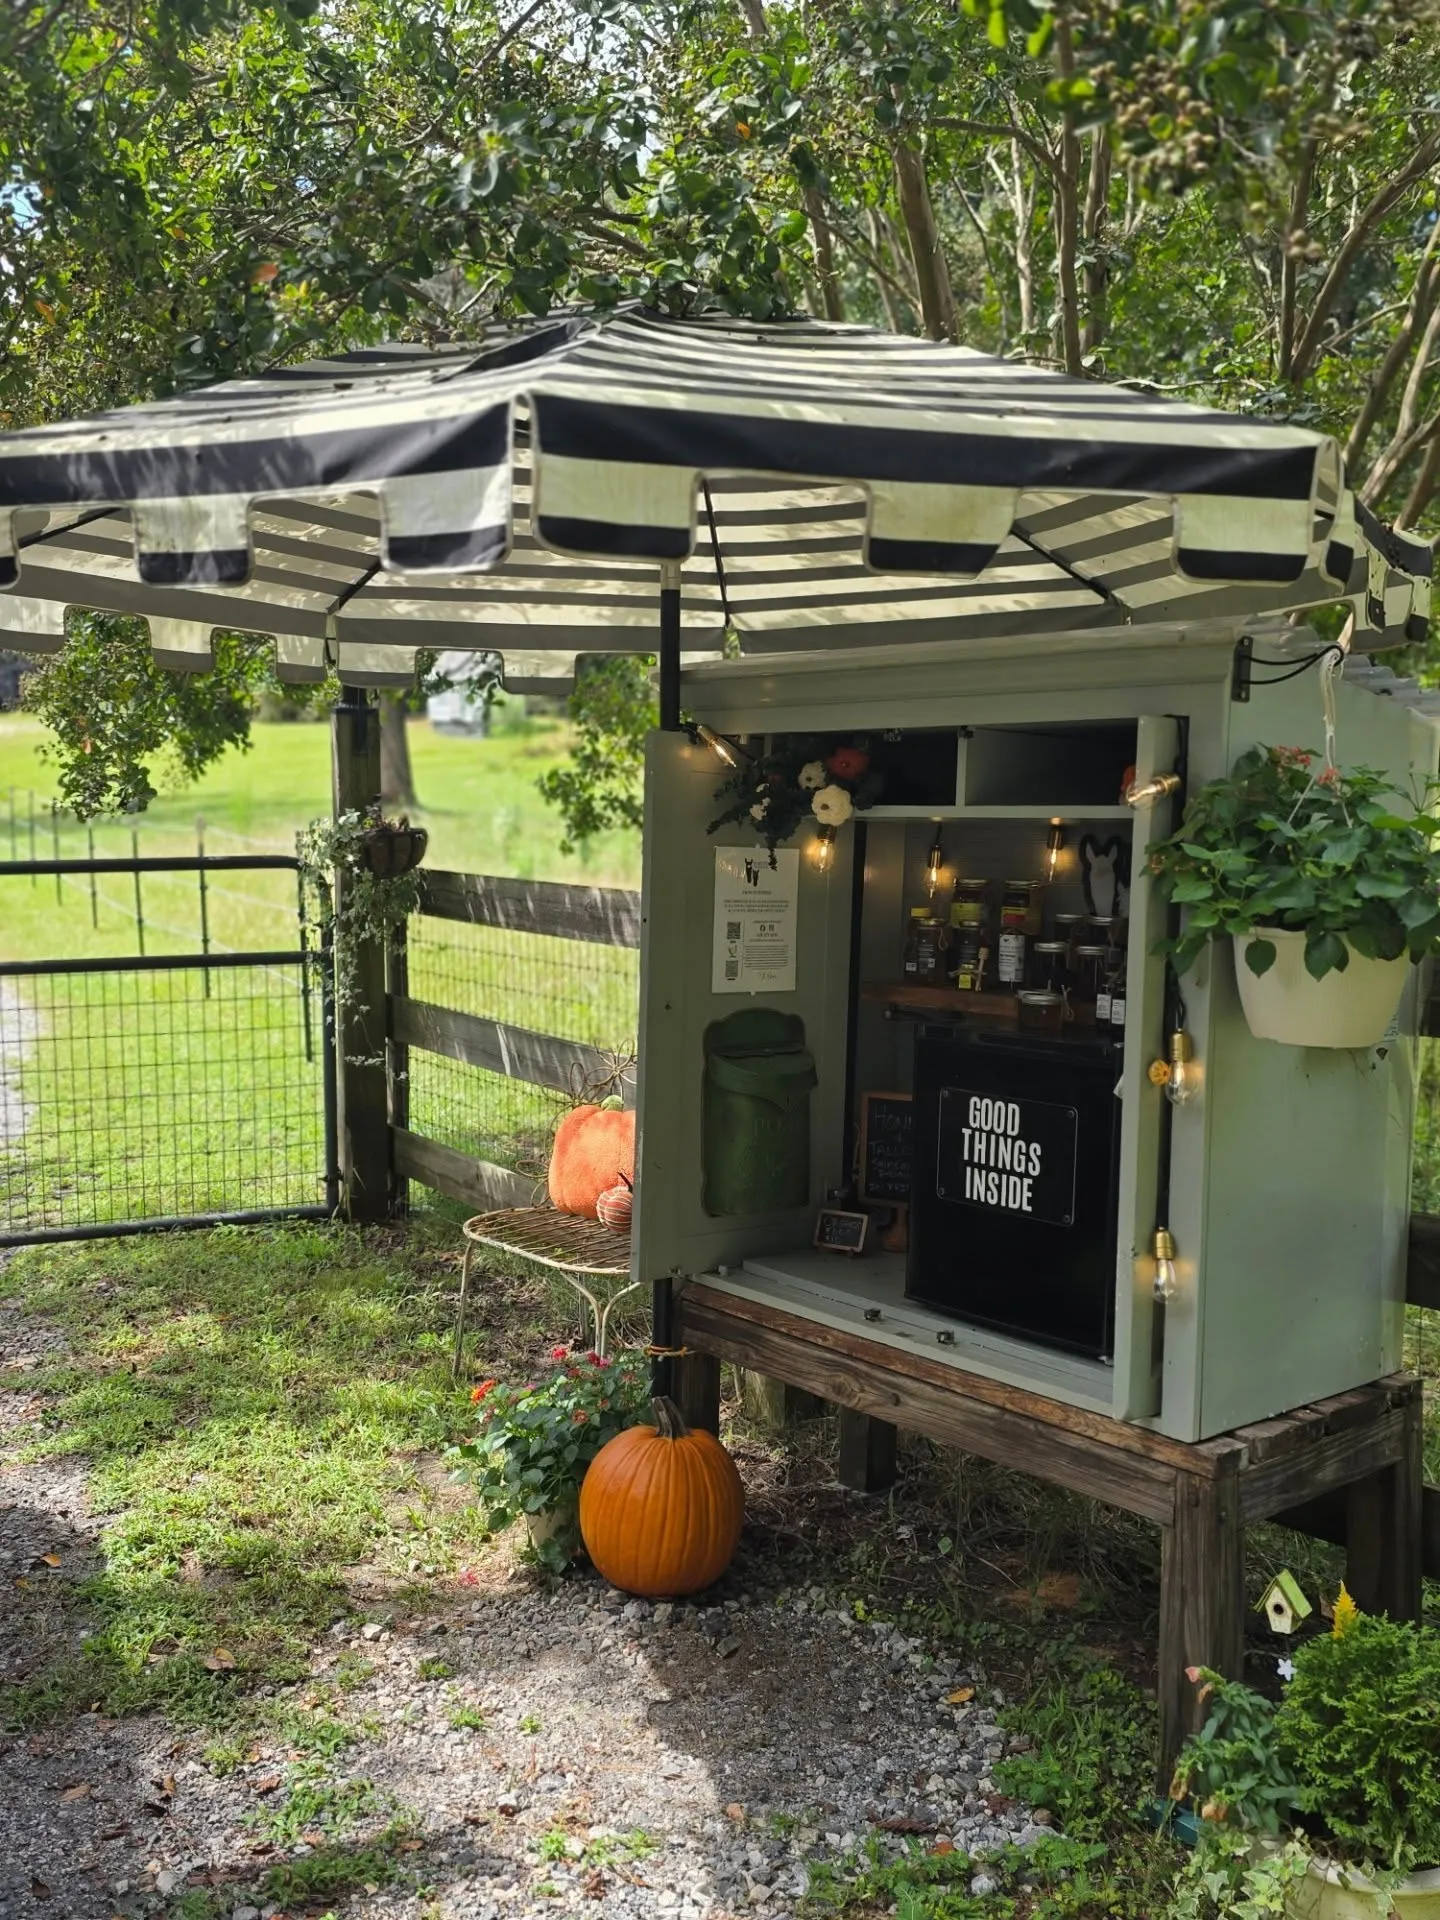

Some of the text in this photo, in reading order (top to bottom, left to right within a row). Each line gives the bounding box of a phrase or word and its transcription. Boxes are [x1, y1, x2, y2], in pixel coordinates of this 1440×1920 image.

[968, 1096, 1020, 1136] GOOD
[961, 1128, 1042, 1176] THINGS
[965, 1166, 1034, 1213] INSIDE
